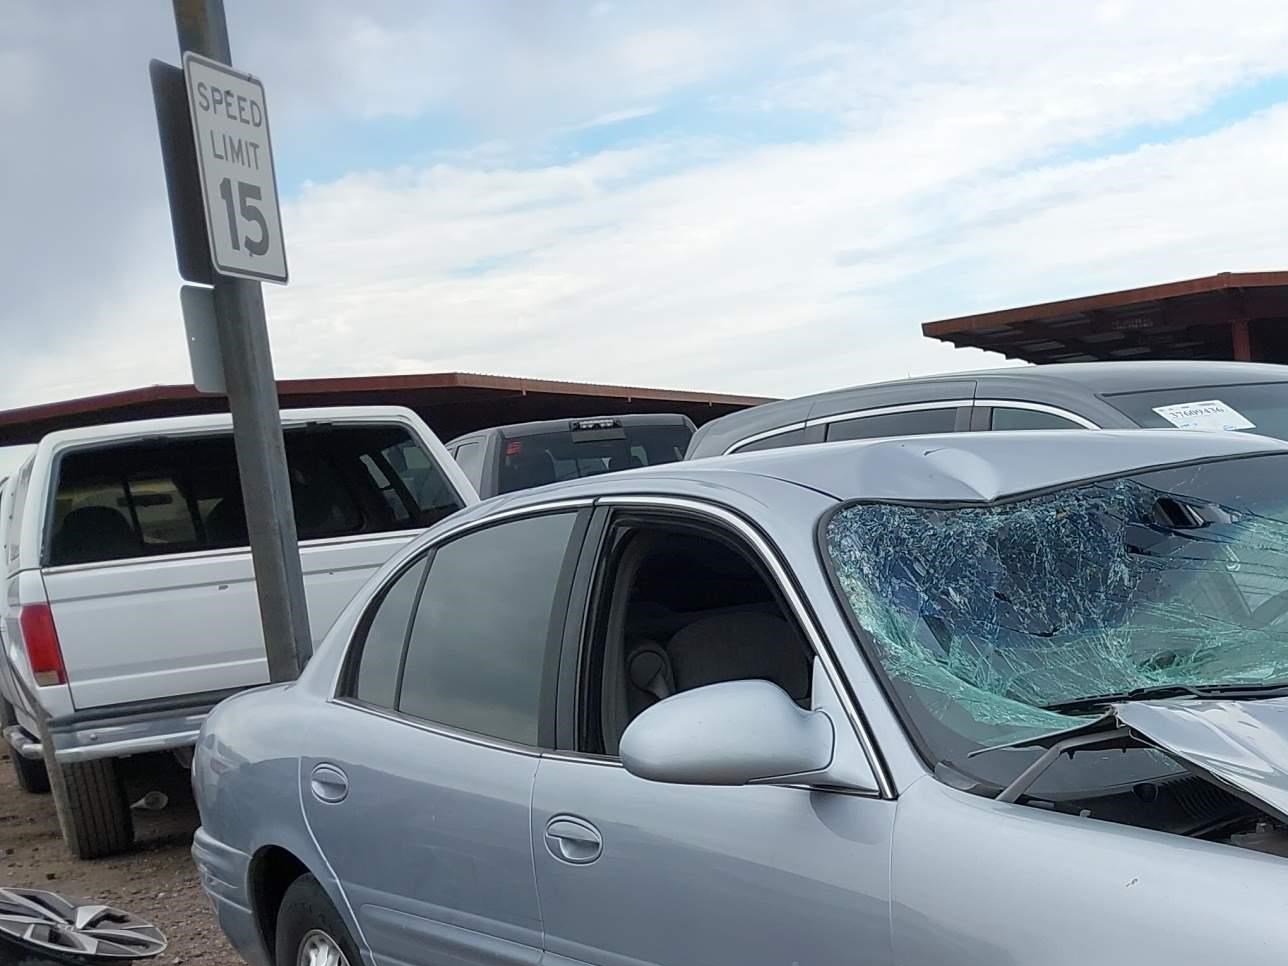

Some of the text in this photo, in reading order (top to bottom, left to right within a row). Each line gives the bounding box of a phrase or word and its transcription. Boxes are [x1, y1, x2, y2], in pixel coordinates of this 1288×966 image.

[197, 82, 262, 127] SPEED
[210, 130, 260, 169] LIMIT
[220, 177, 269, 256] 15
